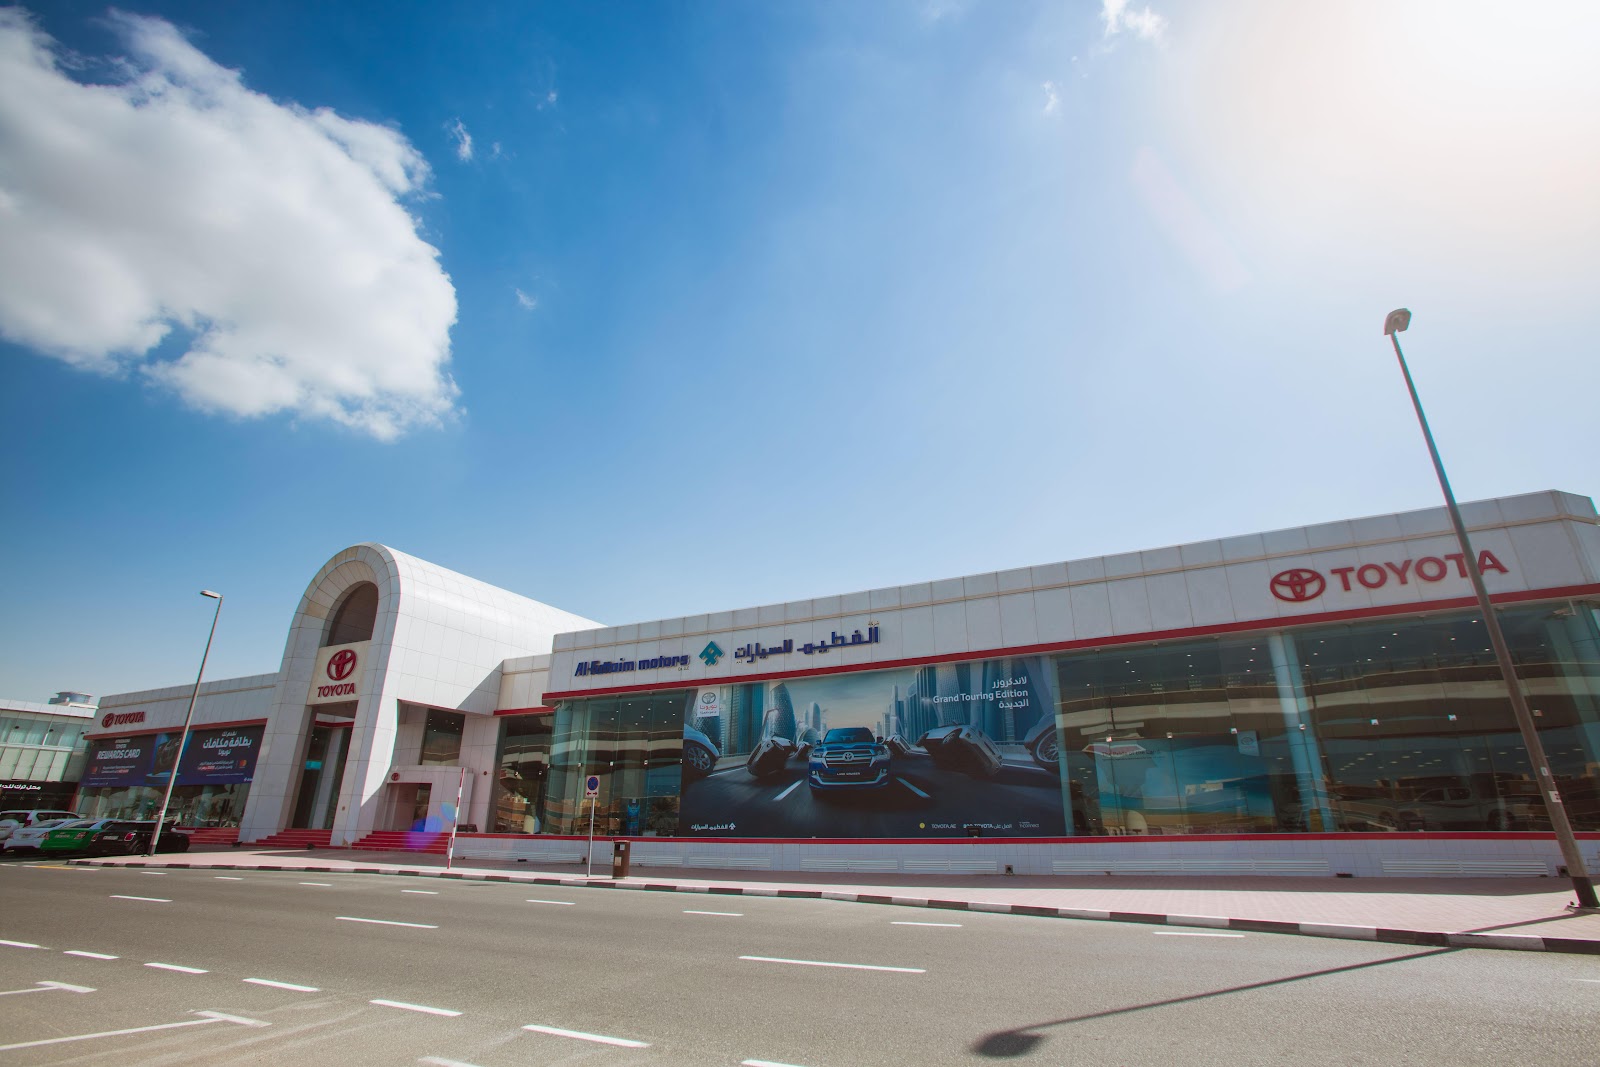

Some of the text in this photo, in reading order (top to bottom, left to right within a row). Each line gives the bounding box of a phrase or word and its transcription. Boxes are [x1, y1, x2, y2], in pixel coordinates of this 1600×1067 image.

[1331, 550, 1509, 592] TOYOTA
[735, 626, 879, 663] الفطيم للسيارات
[638, 654, 690, 671] motors
[992, 676, 1028, 689] لاندكروزر
[317, 682, 356, 698] TOYOTA
[933, 690, 1029, 704] Grand Touring Edition
[998, 699, 1029, 709] الجديدة
[114, 711, 146, 725] TOYOTA
[96, 748, 141, 760] REWARDS CARD
